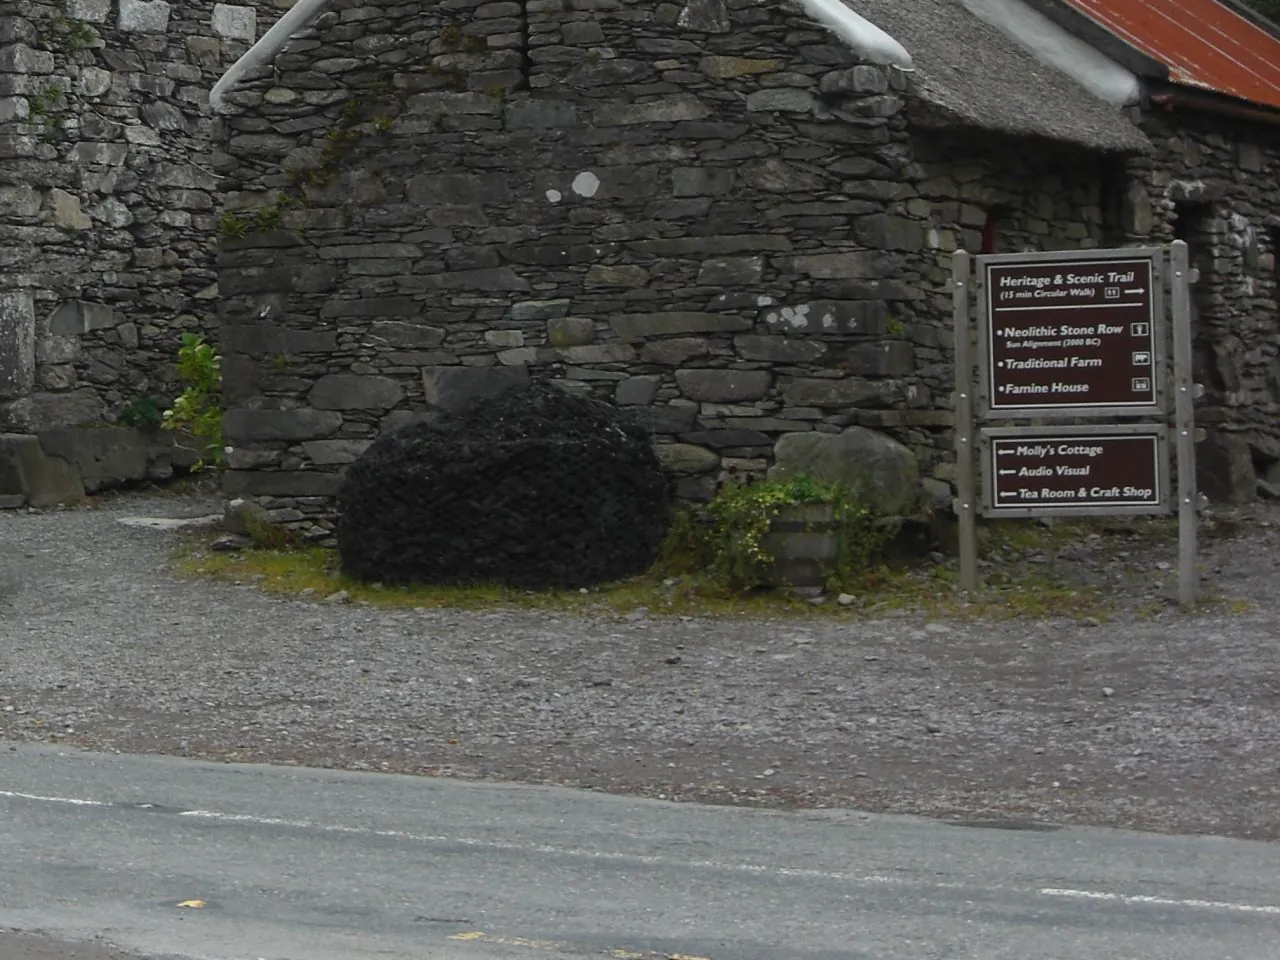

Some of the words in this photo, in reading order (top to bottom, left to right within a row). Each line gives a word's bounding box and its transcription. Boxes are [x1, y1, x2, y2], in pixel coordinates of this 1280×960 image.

[1000, 275, 1051, 288] Heritage
[1053, 274, 1063, 285] &
[1066, 273, 1104, 284] Scenic
[1107, 272, 1134, 283] Trail
[1000, 291, 1014, 300] (15
[1015, 290, 1032, 298] min
[1034, 289, 1067, 298] Circular
[1070, 288, 1096, 297] Walk)
[1004, 325, 1057, 338] Neolithic
[1060, 325, 1094, 336] Stone
[1097, 324, 1123, 334] Row
[1006, 340, 1021, 349] Sun
[1022, 340, 1061, 349] Alignment
[1086, 338, 1101, 348] BC)
[1005, 357, 1067, 369] Traditional
[1070, 357, 1102, 368] Farm
[1005, 383, 1049, 394] Famine
[1051, 382, 1089, 393] House
[1016, 445, 1054, 458] Molly's
[1058, 445, 1103, 457] Cottage
[1019, 466, 1053, 476] Audio
[1056, 465, 1090, 476] Visual
[1019, 488, 1038, 499] Tea
[1041, 488, 1075, 498] Room
[1077, 487, 1087, 498] &
[1090, 487, 1120, 497] Craft
[1122, 486, 1152, 499] Shop
